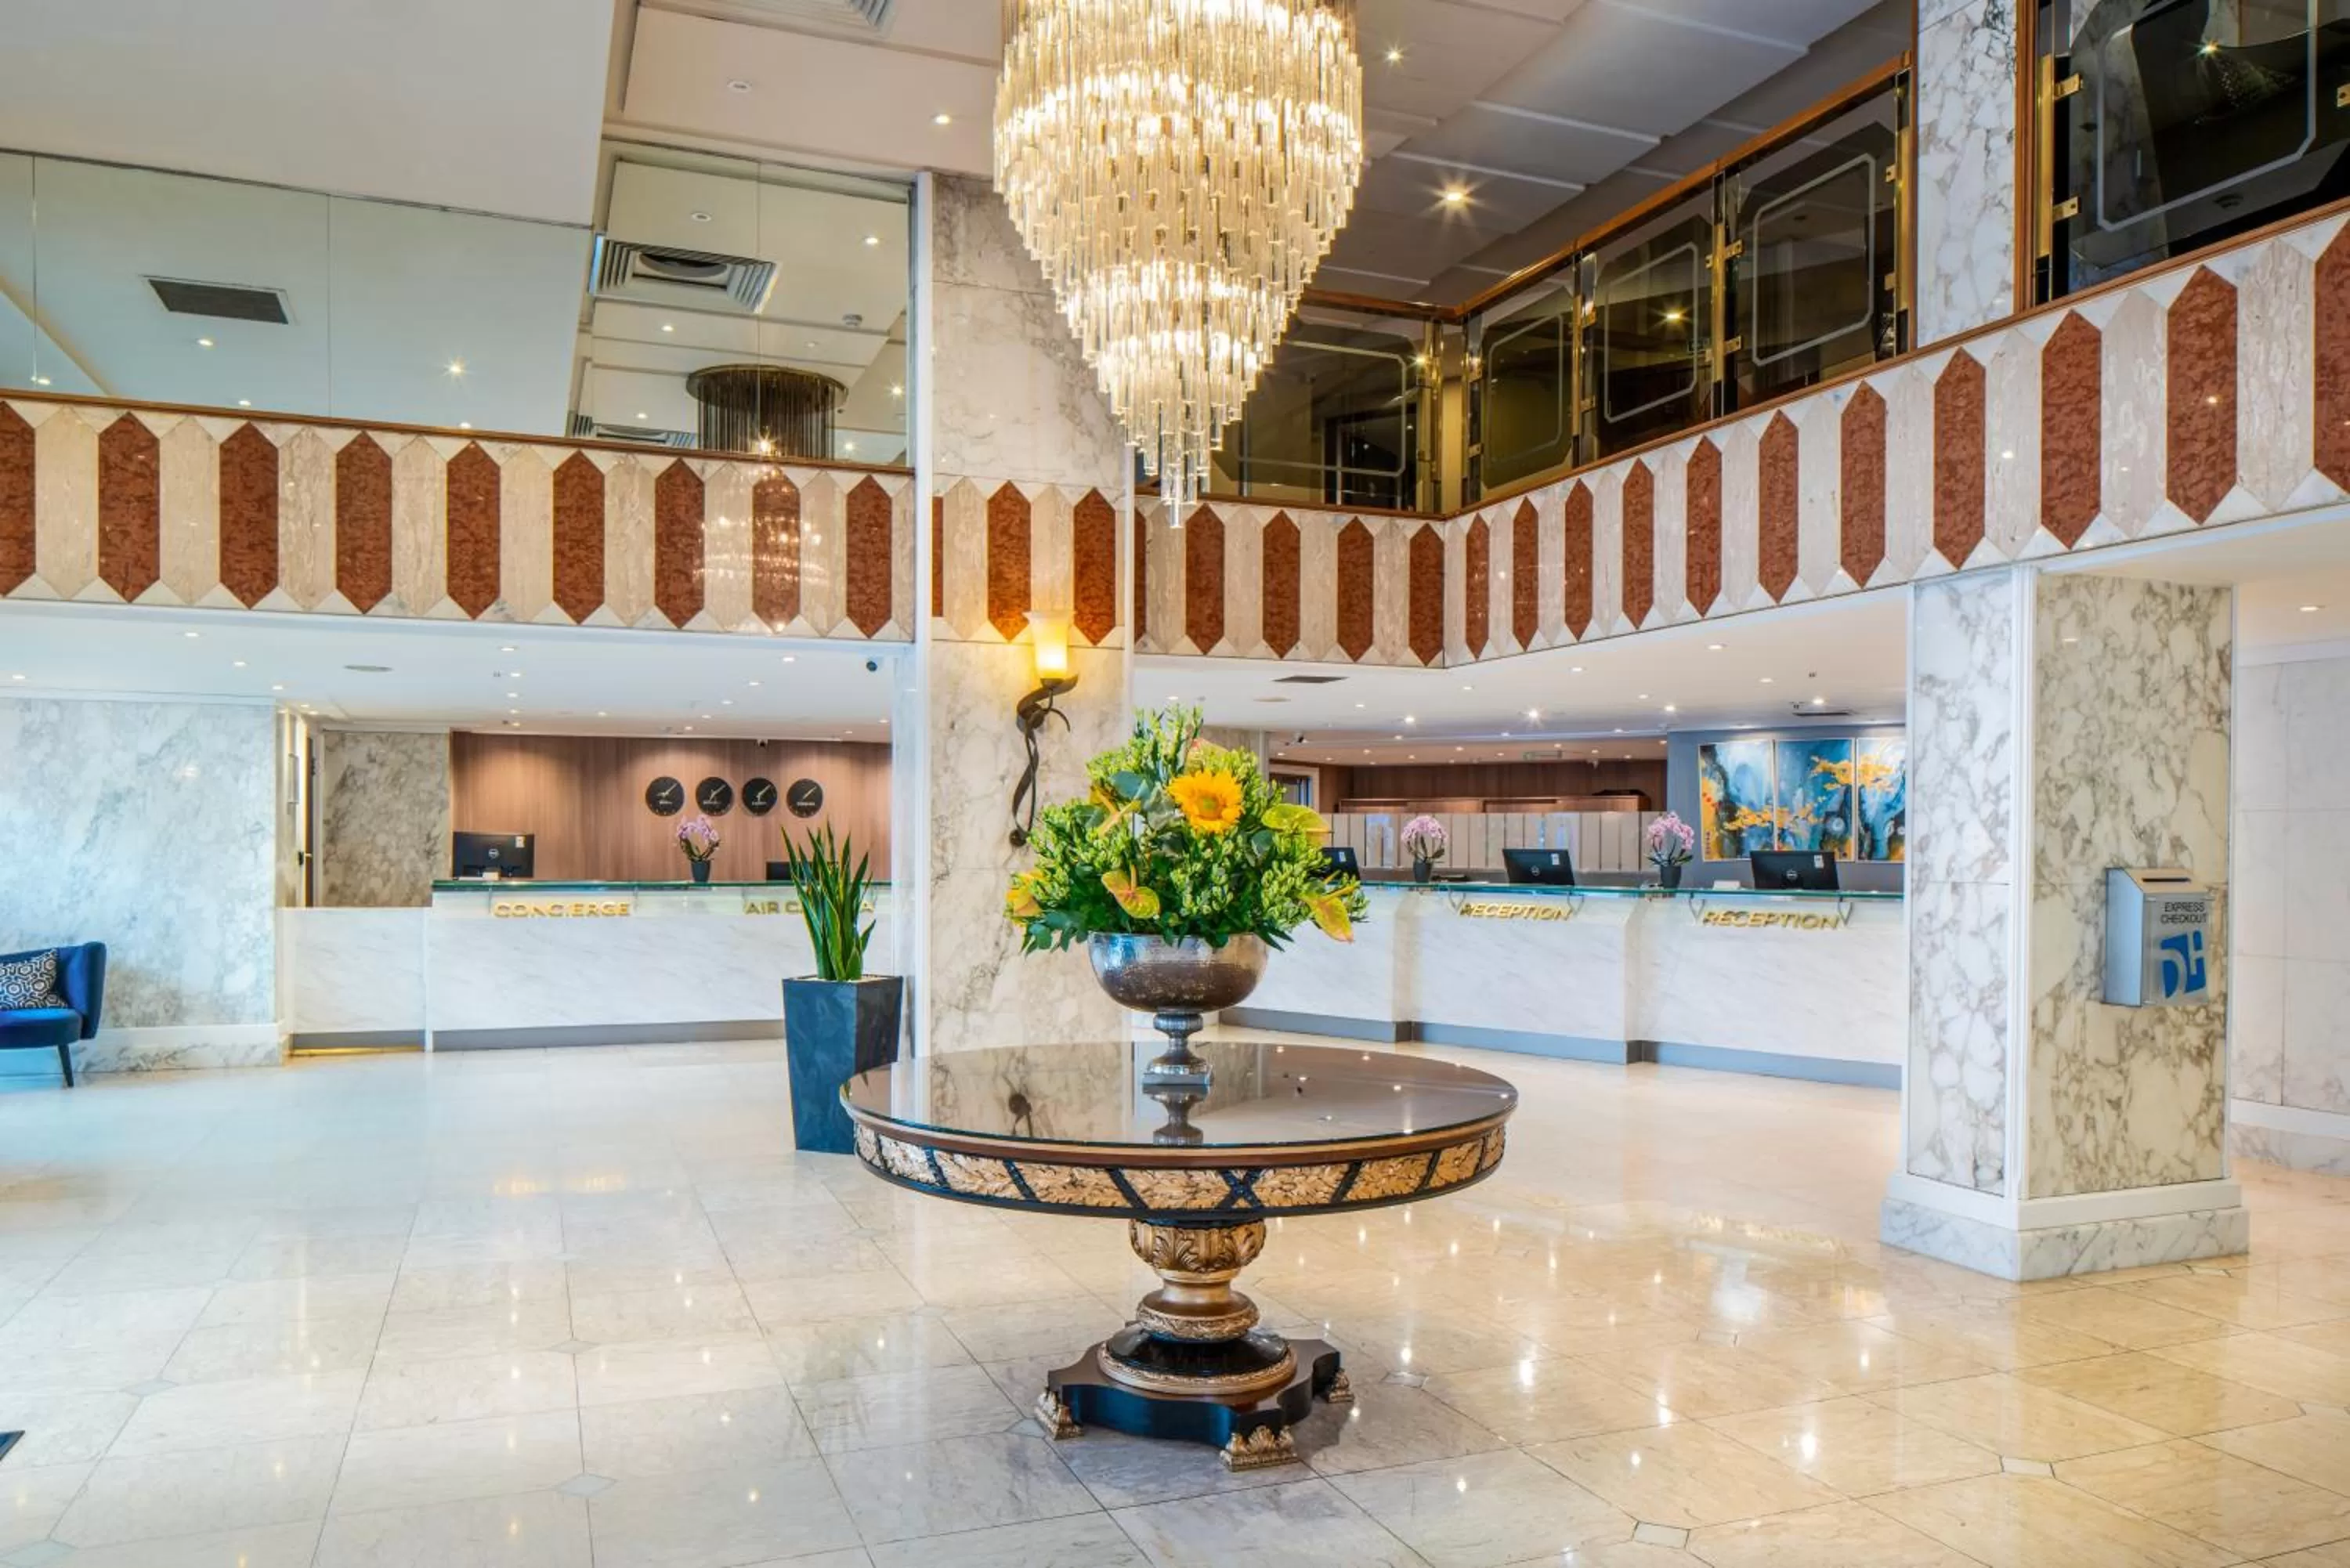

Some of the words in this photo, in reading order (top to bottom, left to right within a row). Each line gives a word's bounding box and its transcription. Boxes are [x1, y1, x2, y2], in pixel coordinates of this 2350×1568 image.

[494, 901, 631, 918] CONCIERGE
[746, 901, 780, 915] AIR
[1459, 902, 1573, 922] RECEPTION
[2164, 901, 2206, 912] EXPRESS
[1702, 910, 1841, 930] RECEPTION
[2160, 913, 2207, 924] CHECKOUT
